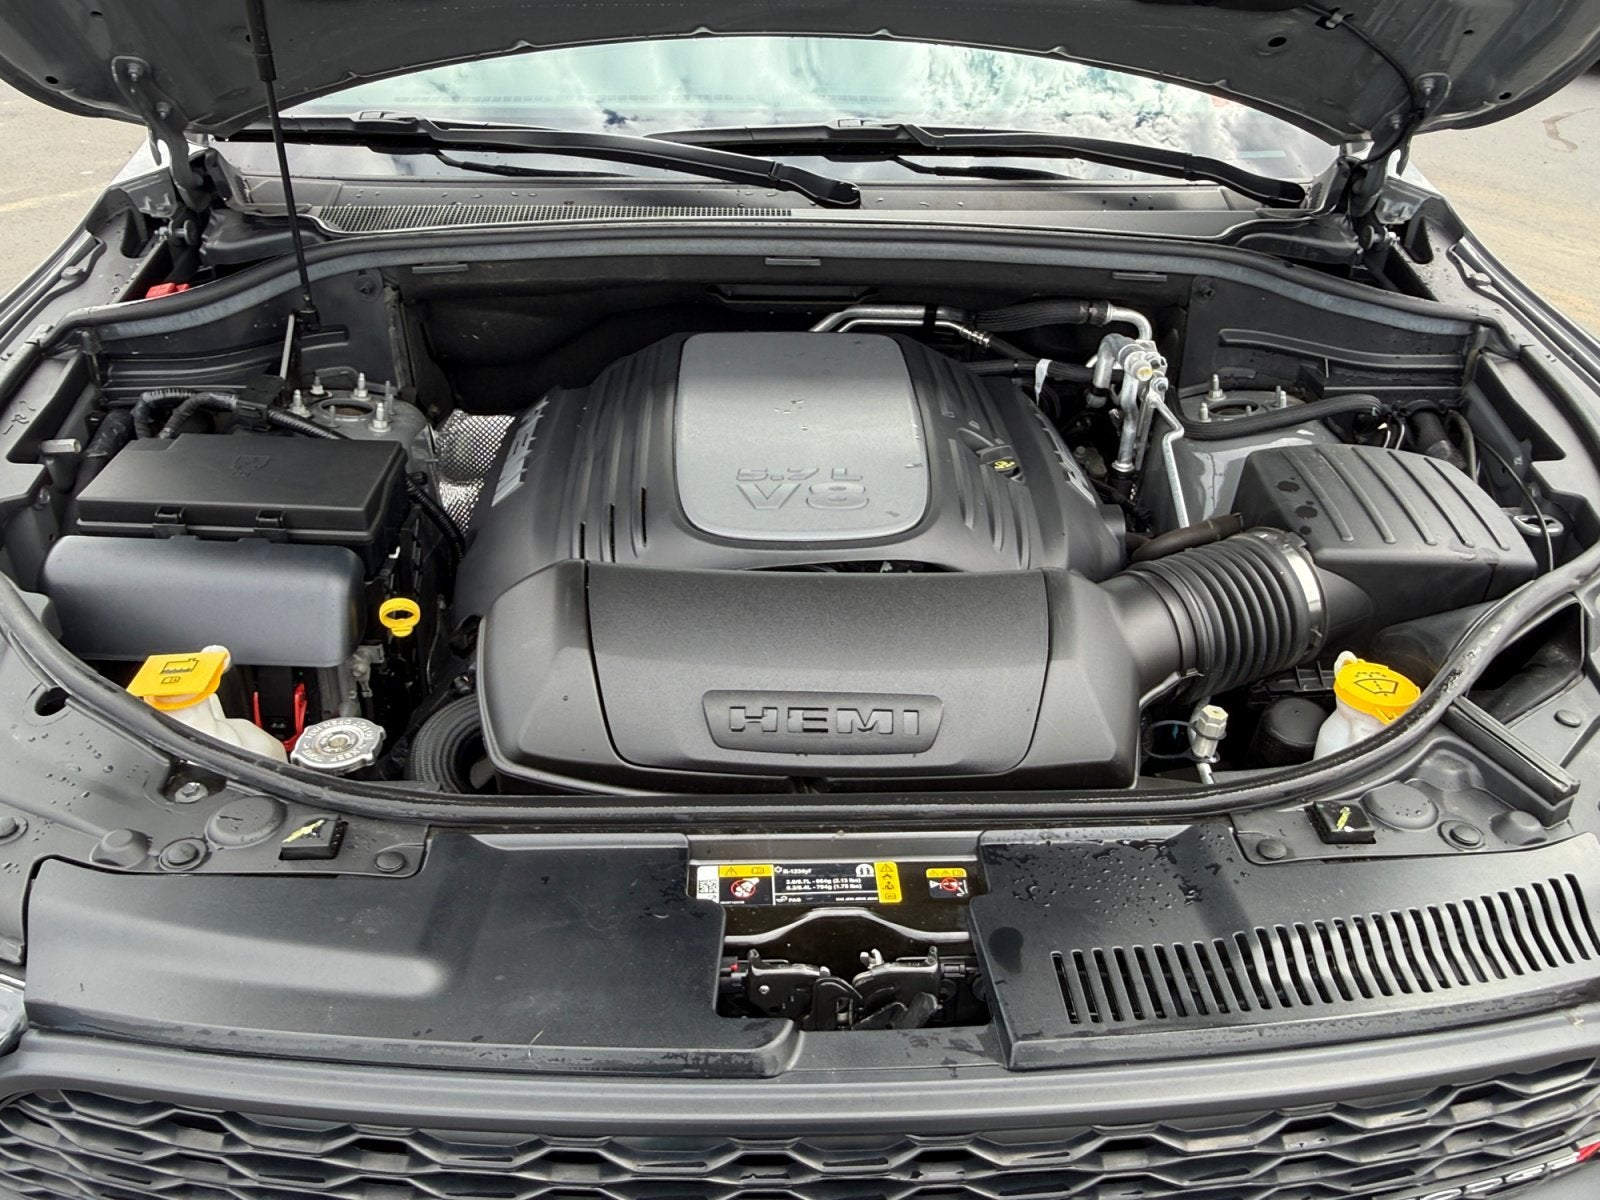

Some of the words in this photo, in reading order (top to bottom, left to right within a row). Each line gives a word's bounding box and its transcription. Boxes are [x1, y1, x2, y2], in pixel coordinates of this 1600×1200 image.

[736, 467, 863, 482] 5.7L
[736, 481, 869, 510] V8
[729, 706, 919, 735] HEMI
